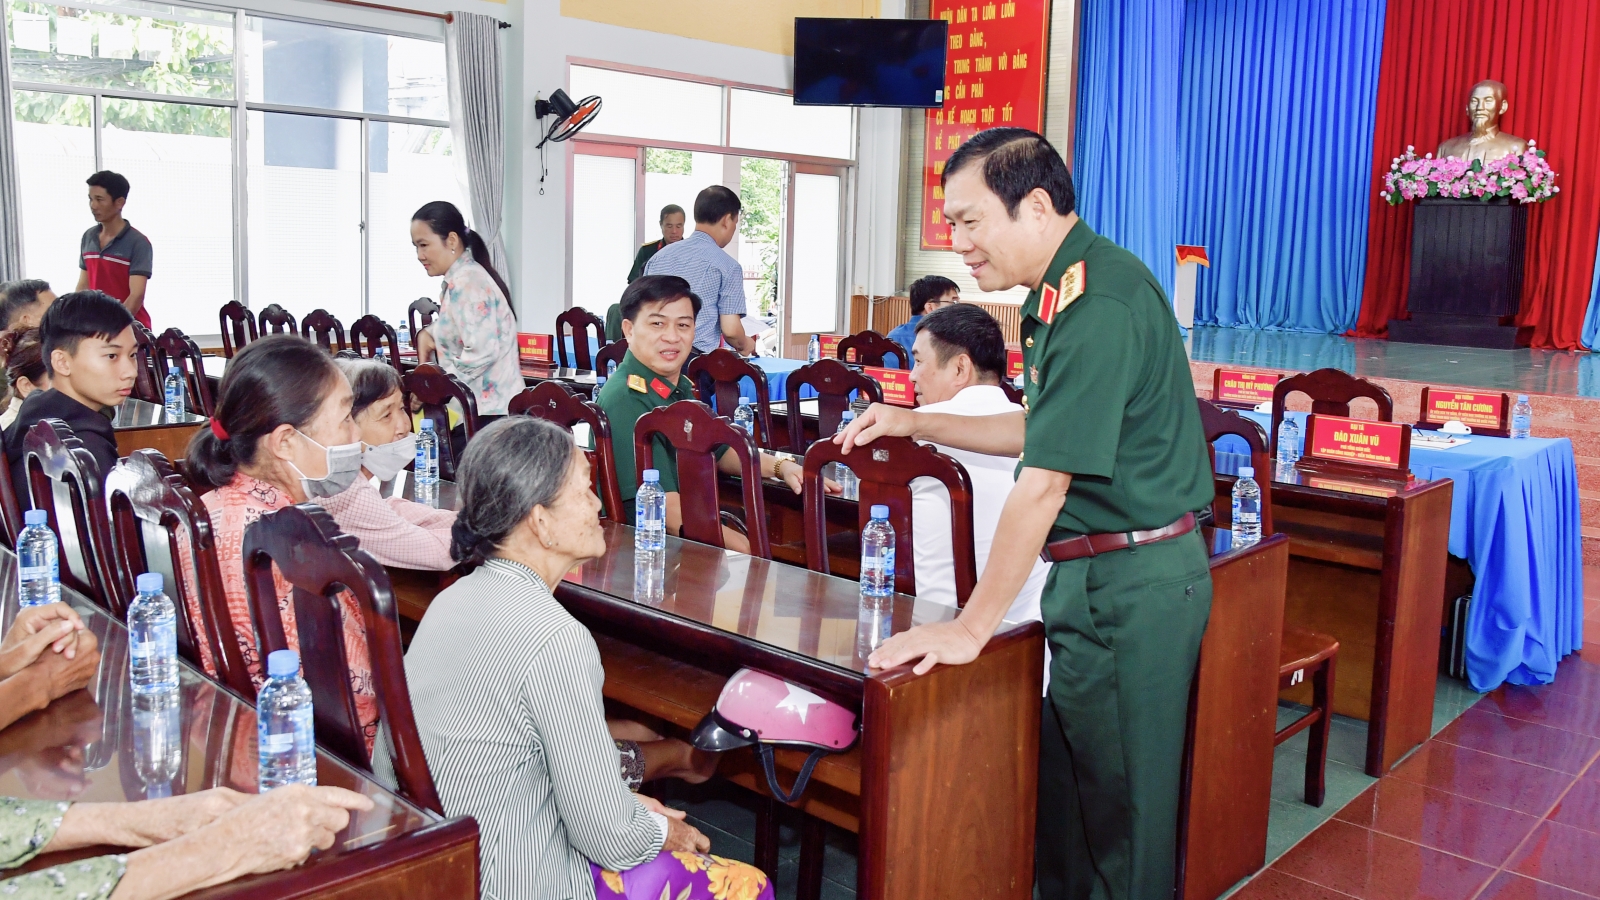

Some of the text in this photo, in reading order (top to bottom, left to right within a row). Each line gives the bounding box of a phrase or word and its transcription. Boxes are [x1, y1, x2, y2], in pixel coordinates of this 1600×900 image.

[971, 7, 977, 22] TA
[982, 2, 996, 20] LUÔN
[950, 34, 962, 49] THEO
[954, 58, 970, 74] TRUNG
[975, 54, 992, 72] THÀNH
[948, 106, 956, 124] KẾ
[960, 109, 976, 126] HOẠCH
[1002, 102, 1013, 121] TỐT
[1436, 399, 1459, 410] NGUYỄN
[1350, 433, 1368, 445] XUÂN
